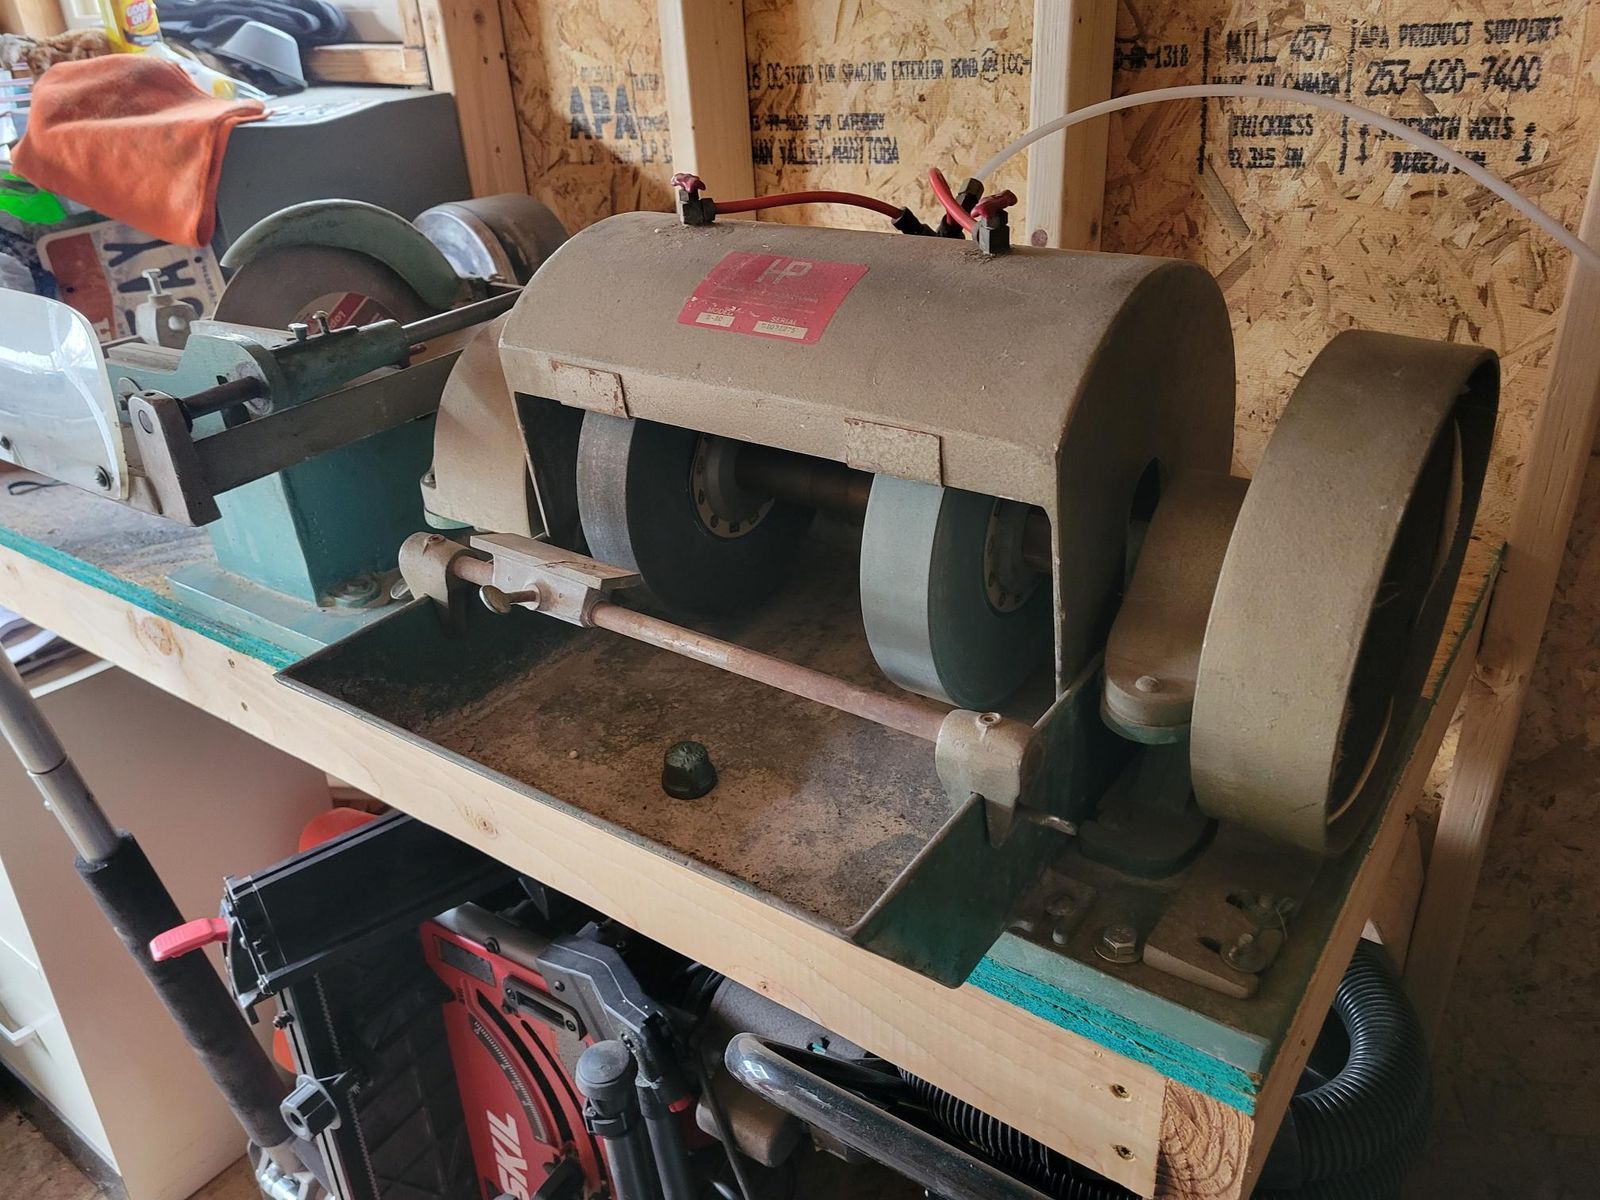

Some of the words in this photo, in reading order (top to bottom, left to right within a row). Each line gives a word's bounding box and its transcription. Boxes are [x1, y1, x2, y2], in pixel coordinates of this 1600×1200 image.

[131, 11, 150, 26] OFF
[1358, 25, 1390, 49] APA
[1400, 21, 1473, 48] PRODUCT
[1484, 16, 1563, 45] SUPPORT
[1225, 29, 1277, 64] MILL
[1290, 24, 1332, 62] 457
[784, 65, 814, 85] SIZED
[818, 63, 837, 84] FOR
[841, 61, 887, 83] SPACING
[891, 59, 944, 81] EXTERIOR
[1365, 55, 1543, 97] 253-620-7400
[570, 85, 638, 140] APA
[1231, 113, 1314, 137] THICKNESS
[707, 305, 735, 316] MODEL
[770, 315, 798, 326] SERIAL
[486, 1108, 531, 1200] SKIL
